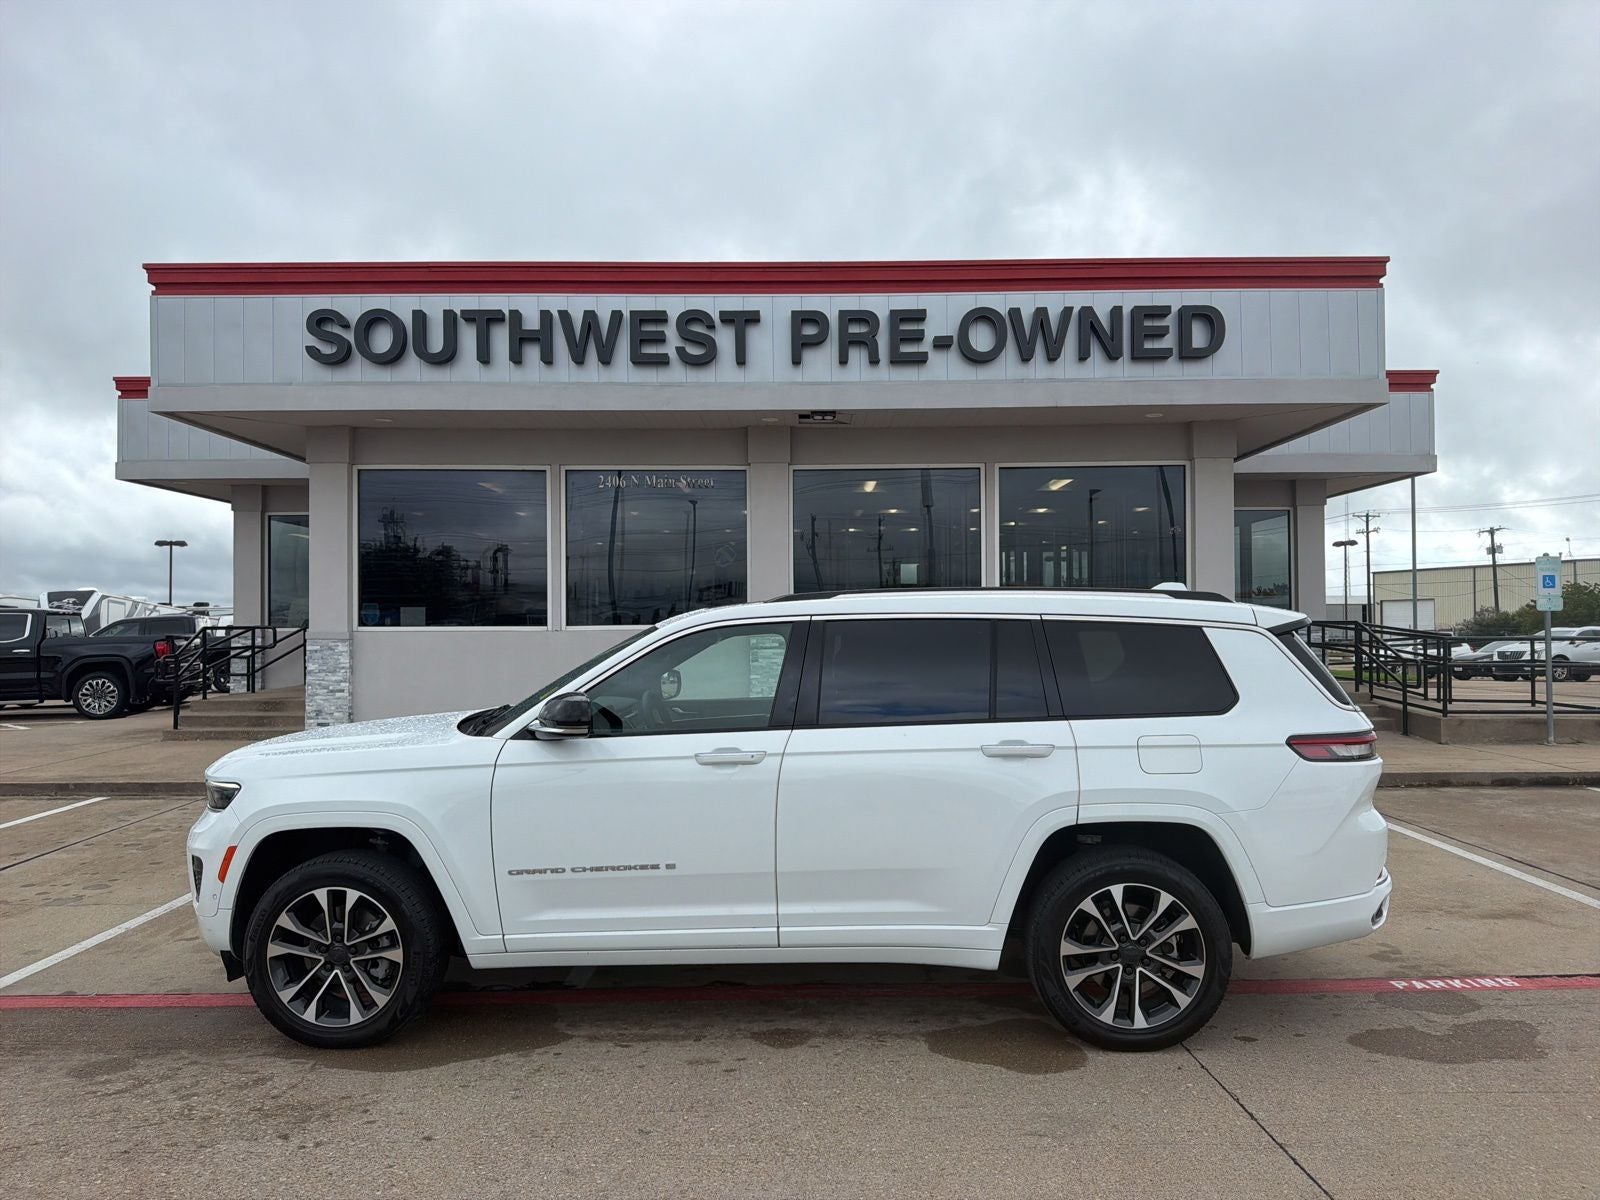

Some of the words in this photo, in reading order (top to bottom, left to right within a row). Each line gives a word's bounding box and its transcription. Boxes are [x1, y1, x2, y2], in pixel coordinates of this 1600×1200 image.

[305, 308, 762, 371] SOUTHWEST
[790, 304, 1227, 370] PRE-OWNED
[631, 475, 639, 488] N
[645, 475, 676, 488] Main
[680, 474, 714, 488] Street
[508, 867, 566, 875] GRAND
[571, 863, 661, 873] CHEROKEE
[1389, 977, 1521, 989] PARKING
